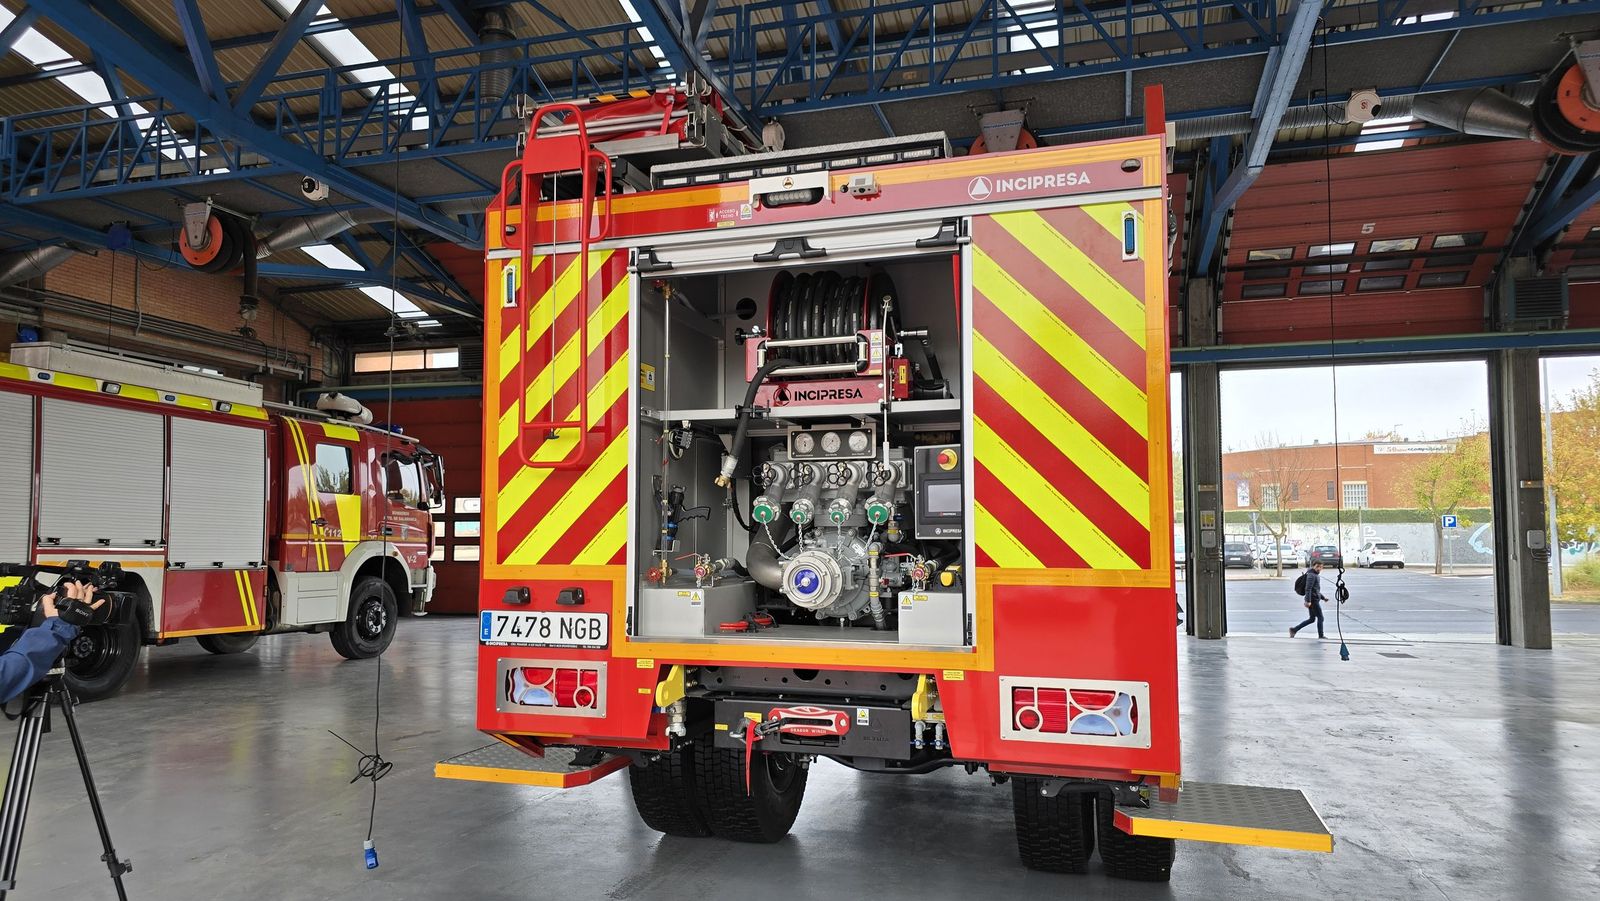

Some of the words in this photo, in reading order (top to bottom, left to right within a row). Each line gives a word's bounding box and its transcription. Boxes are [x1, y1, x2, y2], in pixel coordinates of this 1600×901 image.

[996, 171, 1091, 193] INCIPRESA
[1361, 222, 1376, 234] 5
[794, 388, 863, 401] INCIPRESA
[1445, 516, 1454, 527] P
[327, 528, 342, 537] 112
[496, 615, 551, 638] 7478
[560, 617, 601, 640] NGB
